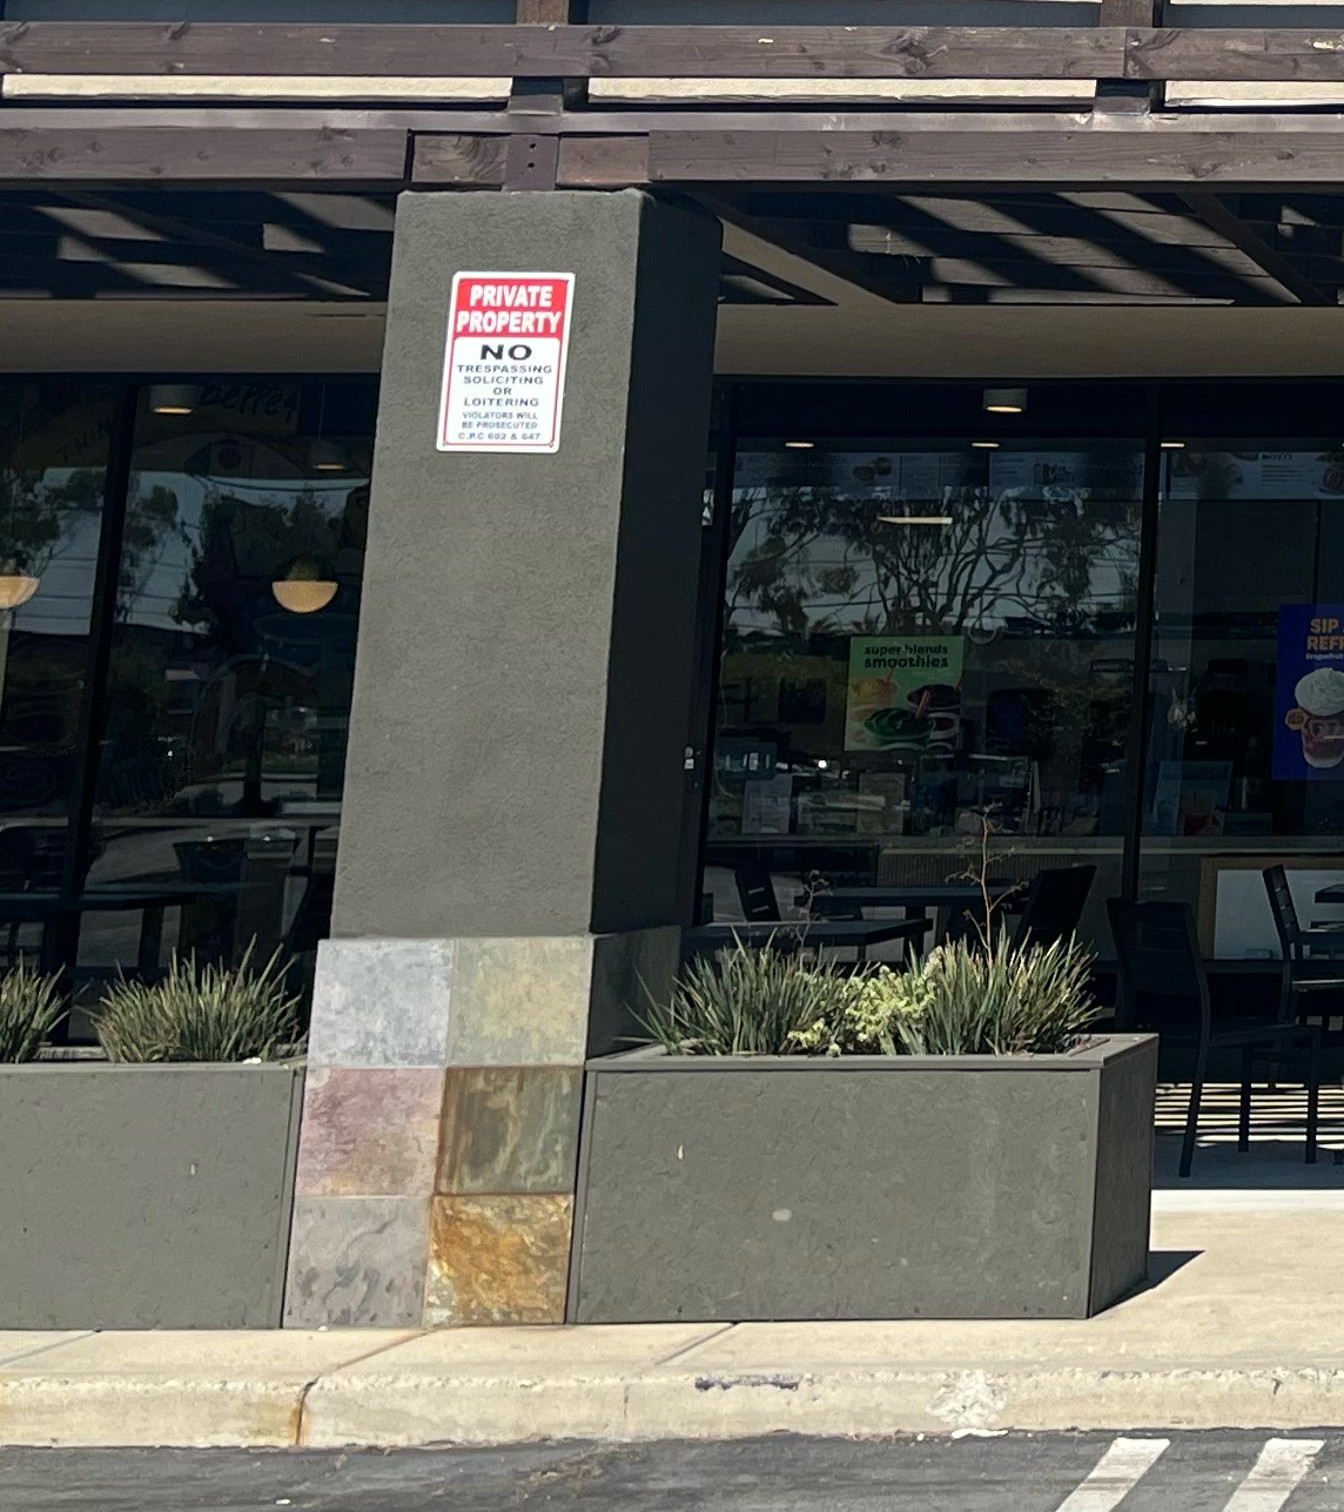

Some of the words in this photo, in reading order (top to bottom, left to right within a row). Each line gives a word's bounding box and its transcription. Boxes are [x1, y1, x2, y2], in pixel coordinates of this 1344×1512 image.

[469, 284, 554, 308] PRIVATE
[456, 310, 562, 333] PROPERTY
[480, 344, 533, 361] NO
[457, 364, 552, 374] TRESPASSING
[463, 376, 544, 385] SOLICITING
[492, 387, 512, 396] OR
[463, 397, 540, 407] LOITERING
[462, 411, 513, 419] VIOLATORS
[516, 411, 539, 420] WILL
[461, 421, 473, 429] BE
[476, 421, 538, 430] PROSECUTED
[1310, 618, 1339, 634] SIP
[864, 646, 901, 656] super
[864, 655, 948, 668] smoothies
